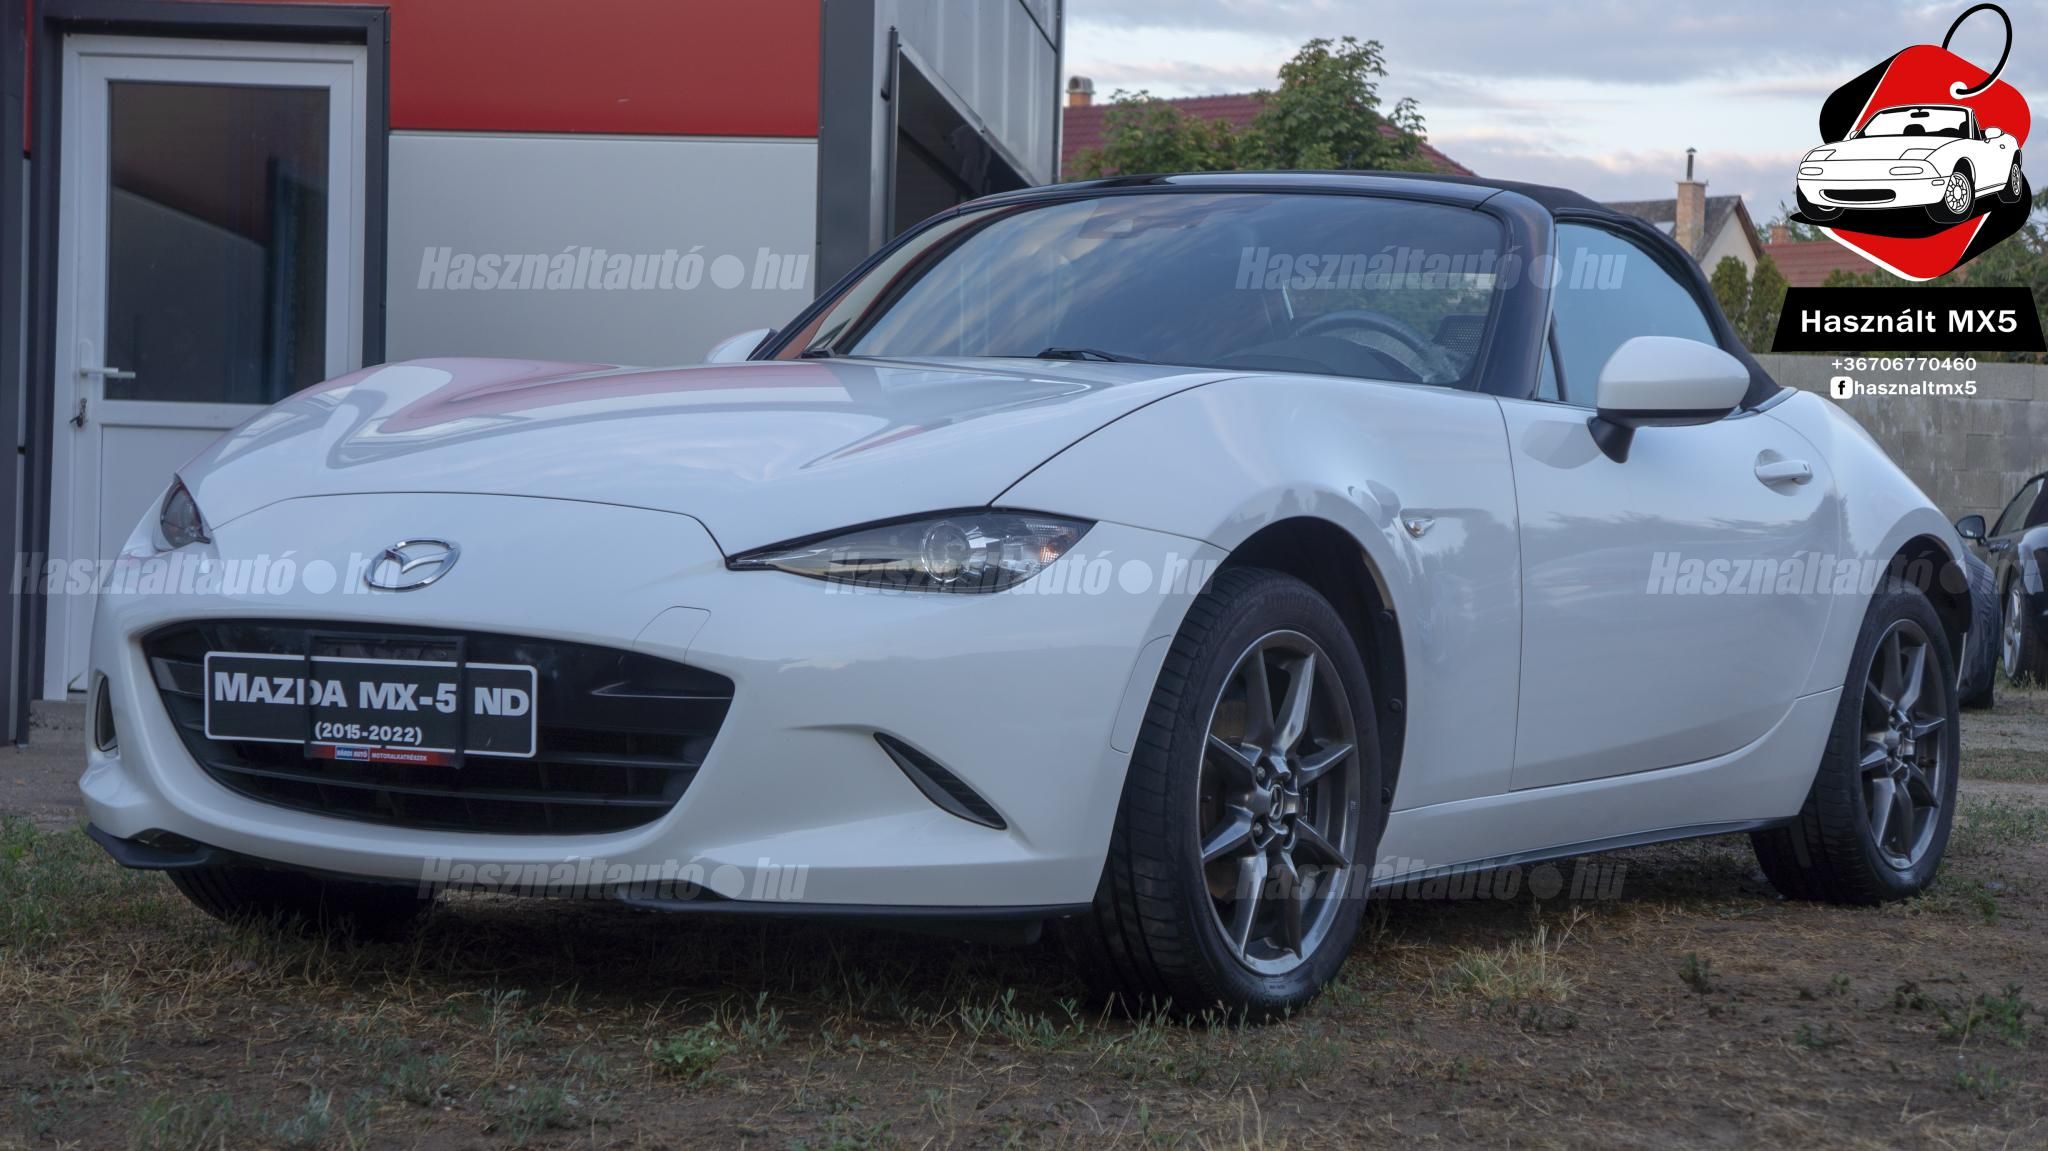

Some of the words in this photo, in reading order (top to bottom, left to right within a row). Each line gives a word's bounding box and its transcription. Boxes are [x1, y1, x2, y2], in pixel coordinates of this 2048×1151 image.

[214, 672, 348, 708] MAZDA
[359, 681, 457, 714] MX-5
[474, 687, 530, 717] ND
[315, 721, 423, 745] (2015-2022)
